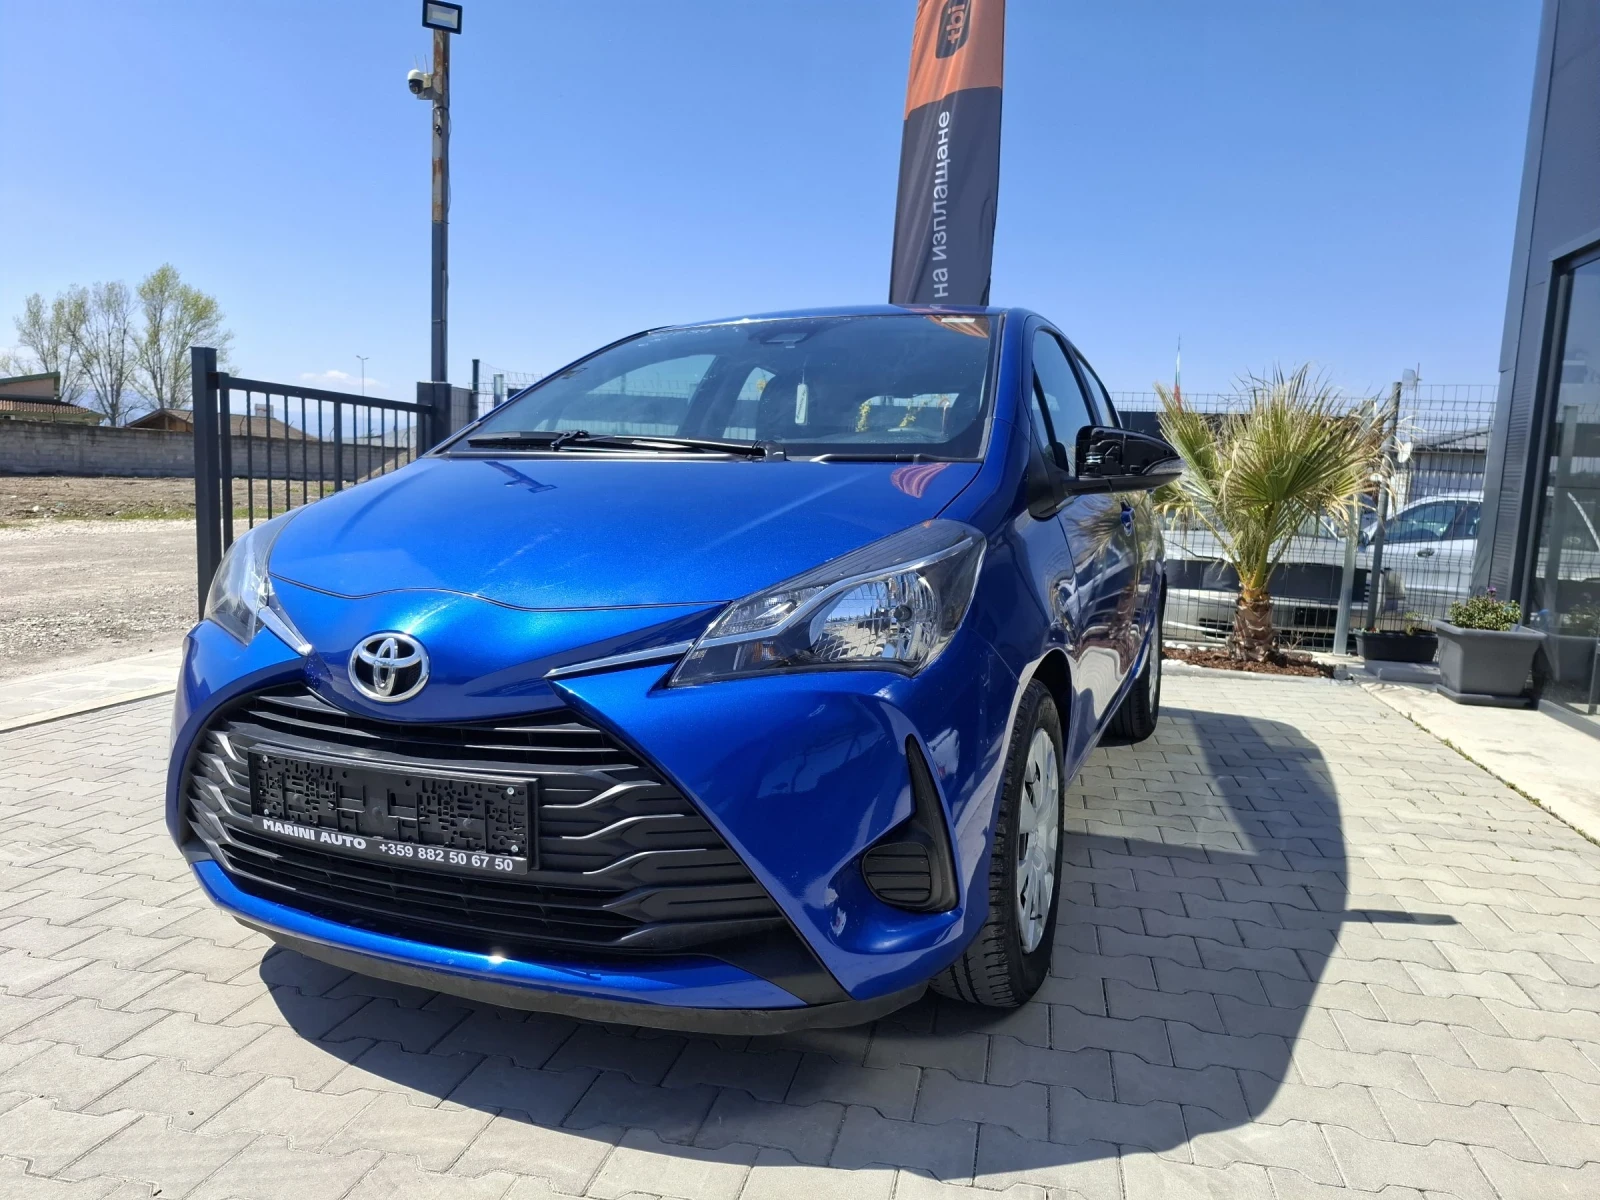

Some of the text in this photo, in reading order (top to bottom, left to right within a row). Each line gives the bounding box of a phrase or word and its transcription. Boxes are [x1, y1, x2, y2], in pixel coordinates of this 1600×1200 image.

[946, 4, 965, 44] tbi
[932, 111, 951, 261] изплащане
[933, 267, 949, 298] на
[263, 819, 513, 872] MARINI AUTO +359 882 50 67 50
